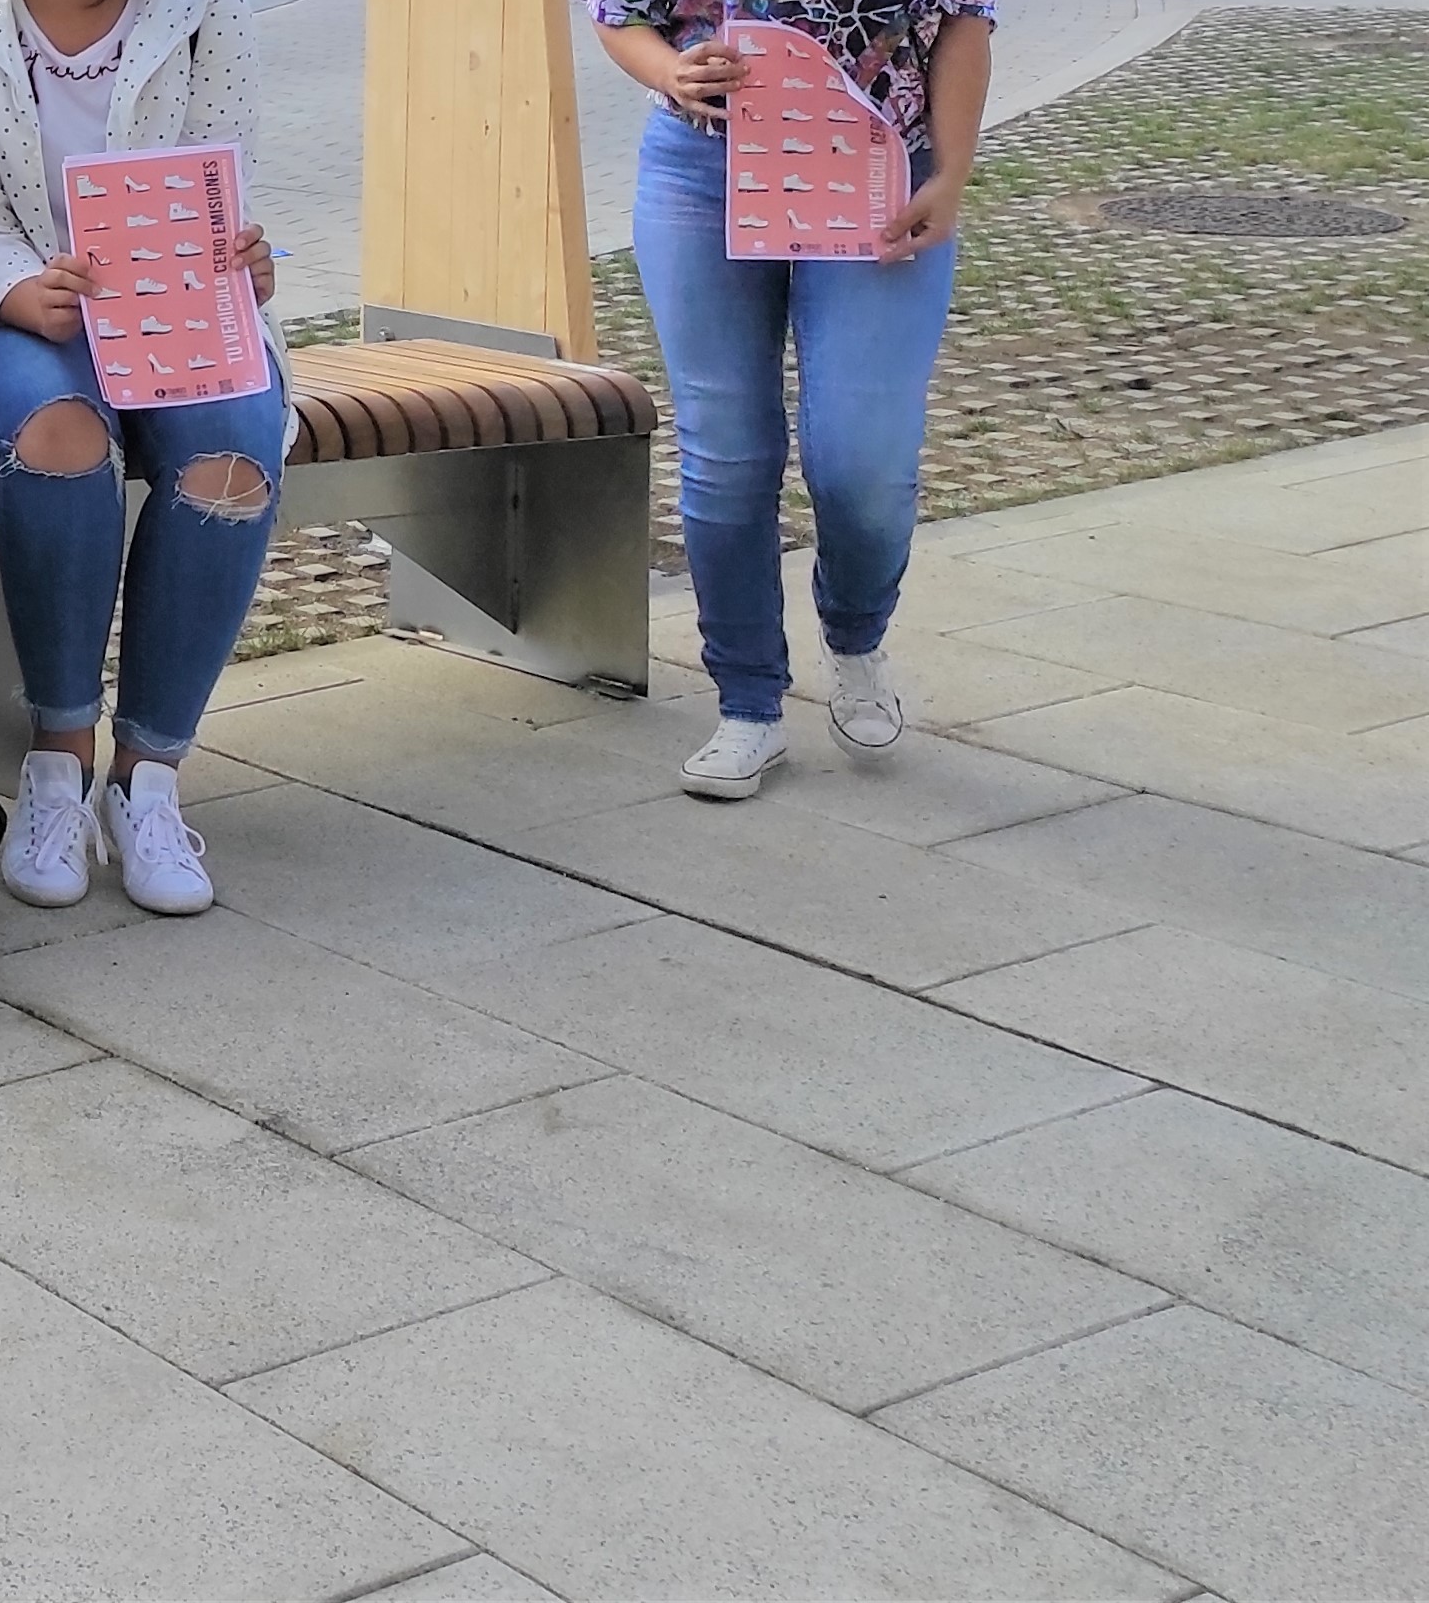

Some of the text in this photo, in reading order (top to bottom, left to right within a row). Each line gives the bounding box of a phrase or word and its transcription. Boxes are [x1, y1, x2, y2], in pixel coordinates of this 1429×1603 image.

[202, 159, 225, 236] EMISIONES
[866, 147, 888, 212] VEHÍCULO
[869, 213, 888, 230] TU
[210, 237, 229, 274] CERO
[214, 276, 239, 345] VEHÍCULO
[226, 345, 245, 366] TU
